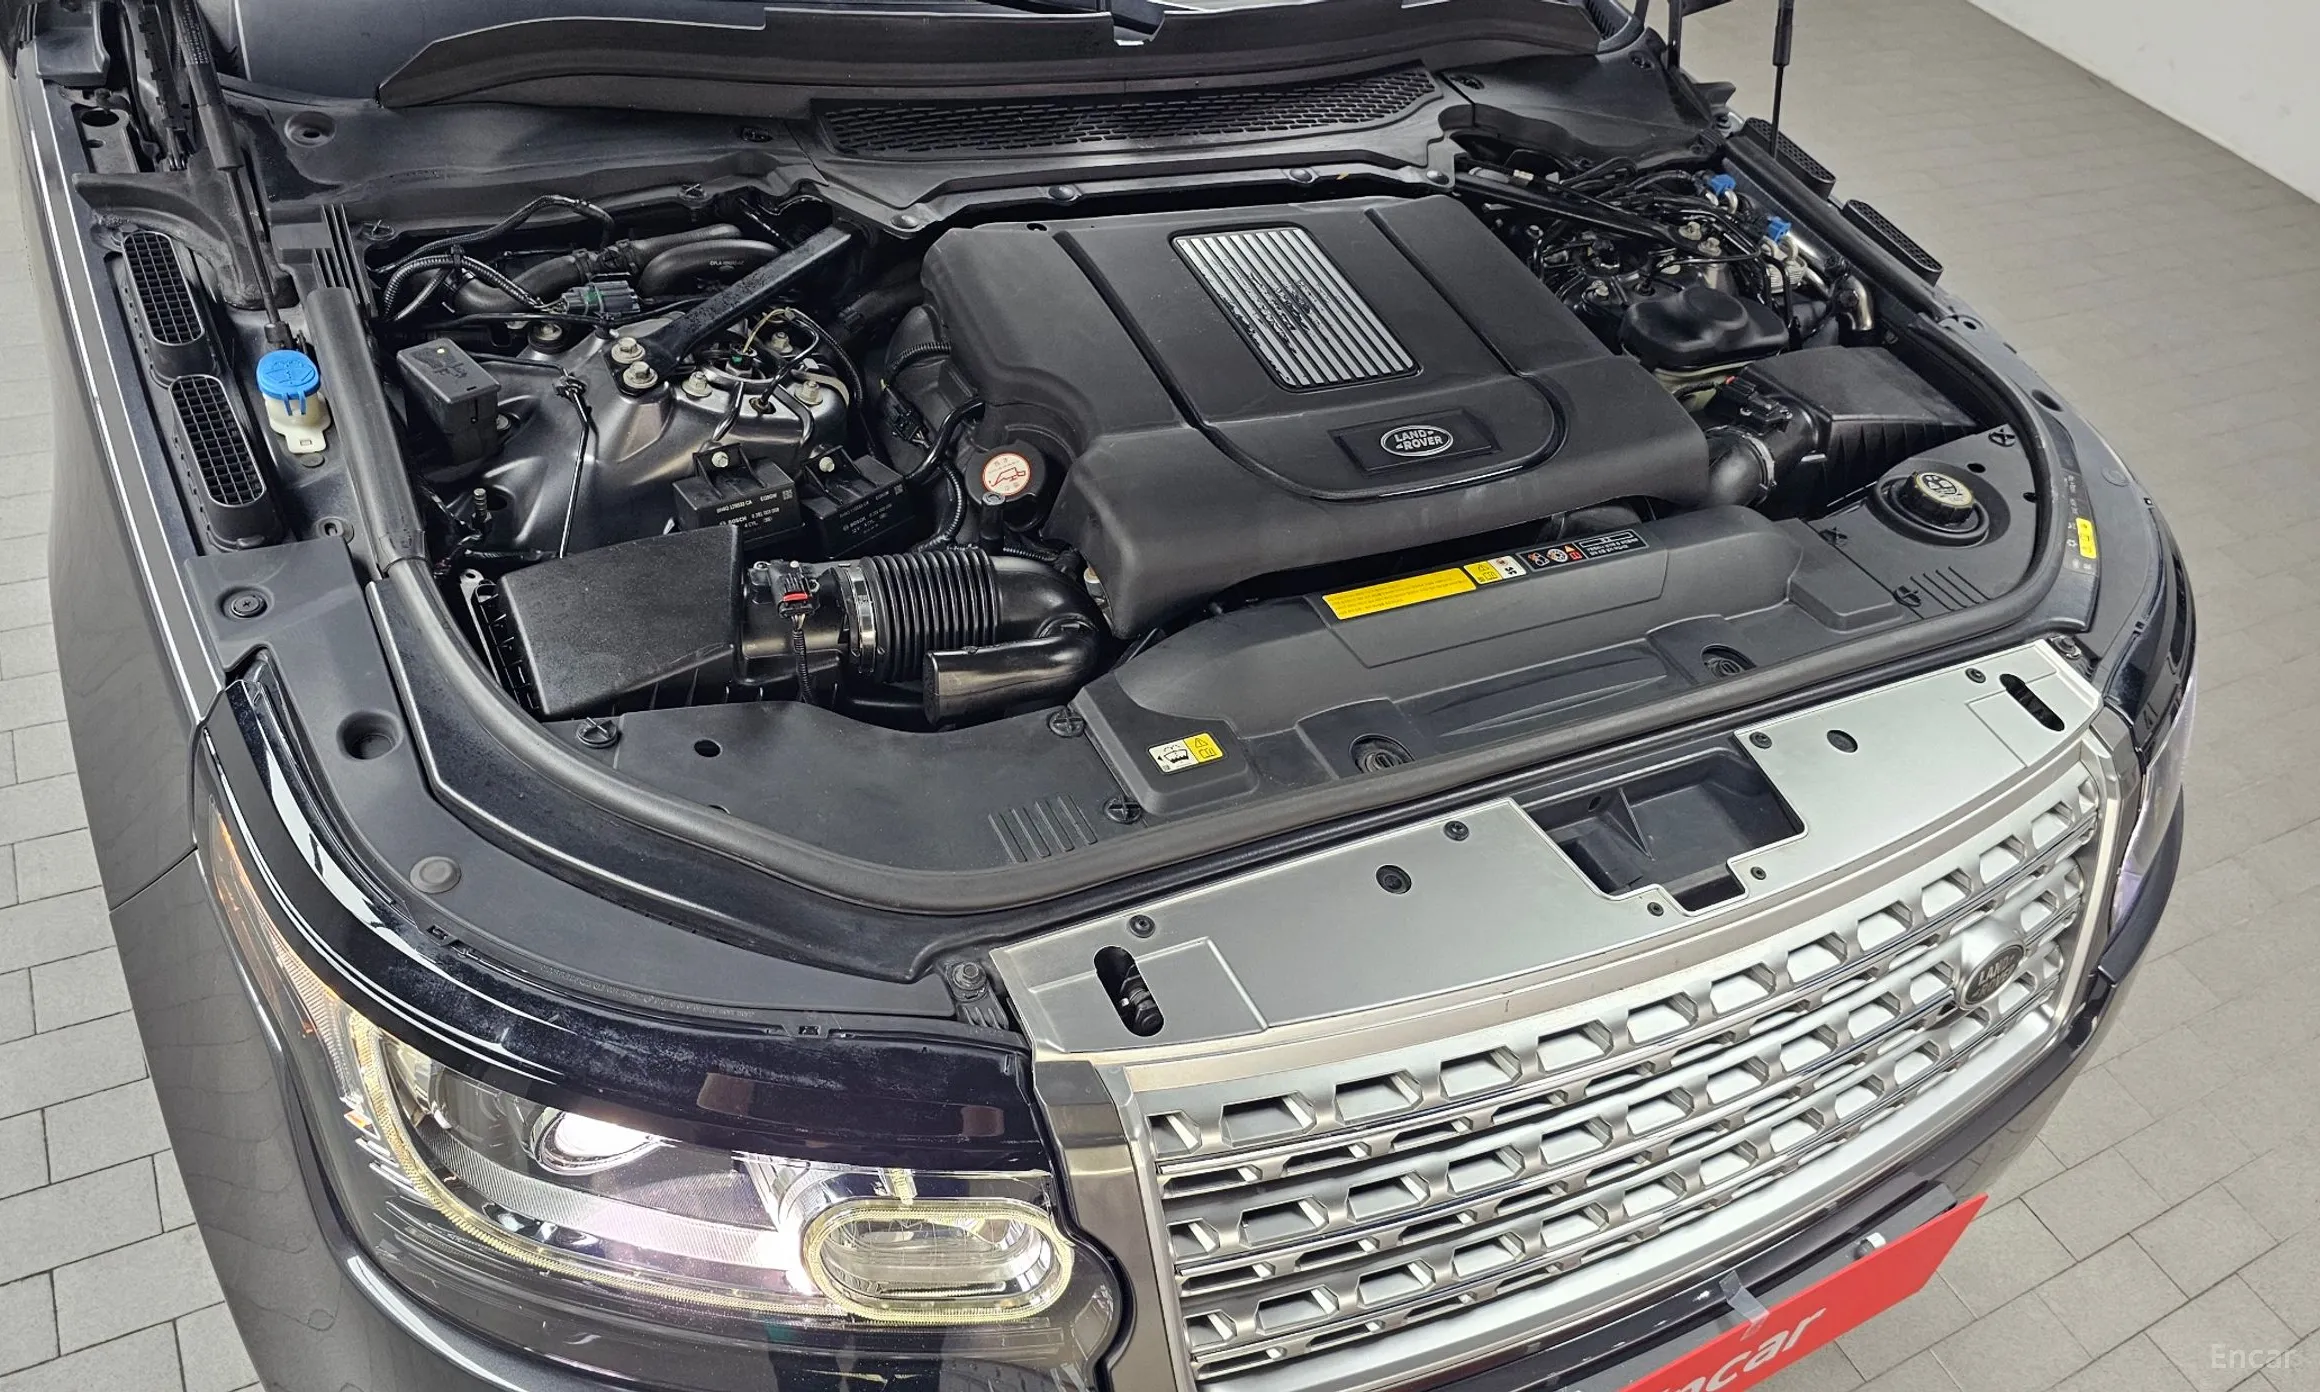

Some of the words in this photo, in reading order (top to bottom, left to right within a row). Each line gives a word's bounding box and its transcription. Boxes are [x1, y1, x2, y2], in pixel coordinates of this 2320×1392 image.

[1394, 429, 1427, 442] LAND
[1403, 436, 1443, 450] ROVER
[1978, 955, 2010, 985] LAND
